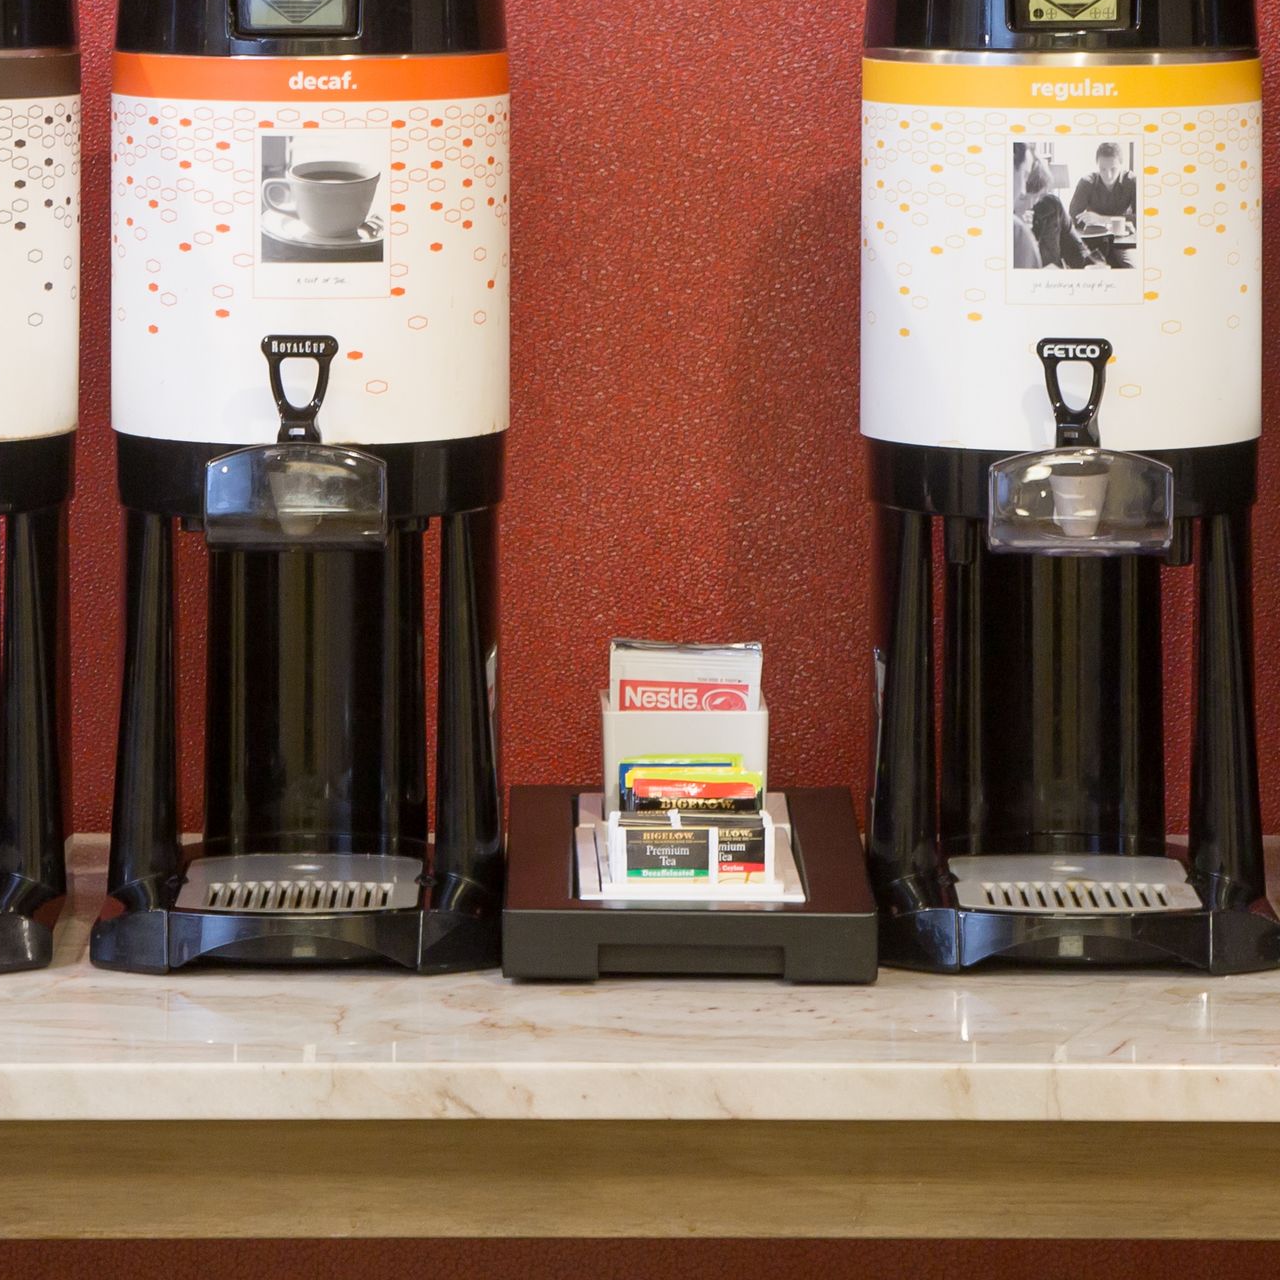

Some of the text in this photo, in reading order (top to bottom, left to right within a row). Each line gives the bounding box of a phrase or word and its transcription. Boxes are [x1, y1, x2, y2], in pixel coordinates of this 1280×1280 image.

[288, 70, 358, 90] decaf.
[1031, 78, 1119, 101] regular.
[1043, 344, 1101, 359] FETCO
[646, 845, 690, 856] Premium
[719, 841, 746, 851] mium
[659, 856, 677, 866] Tea
